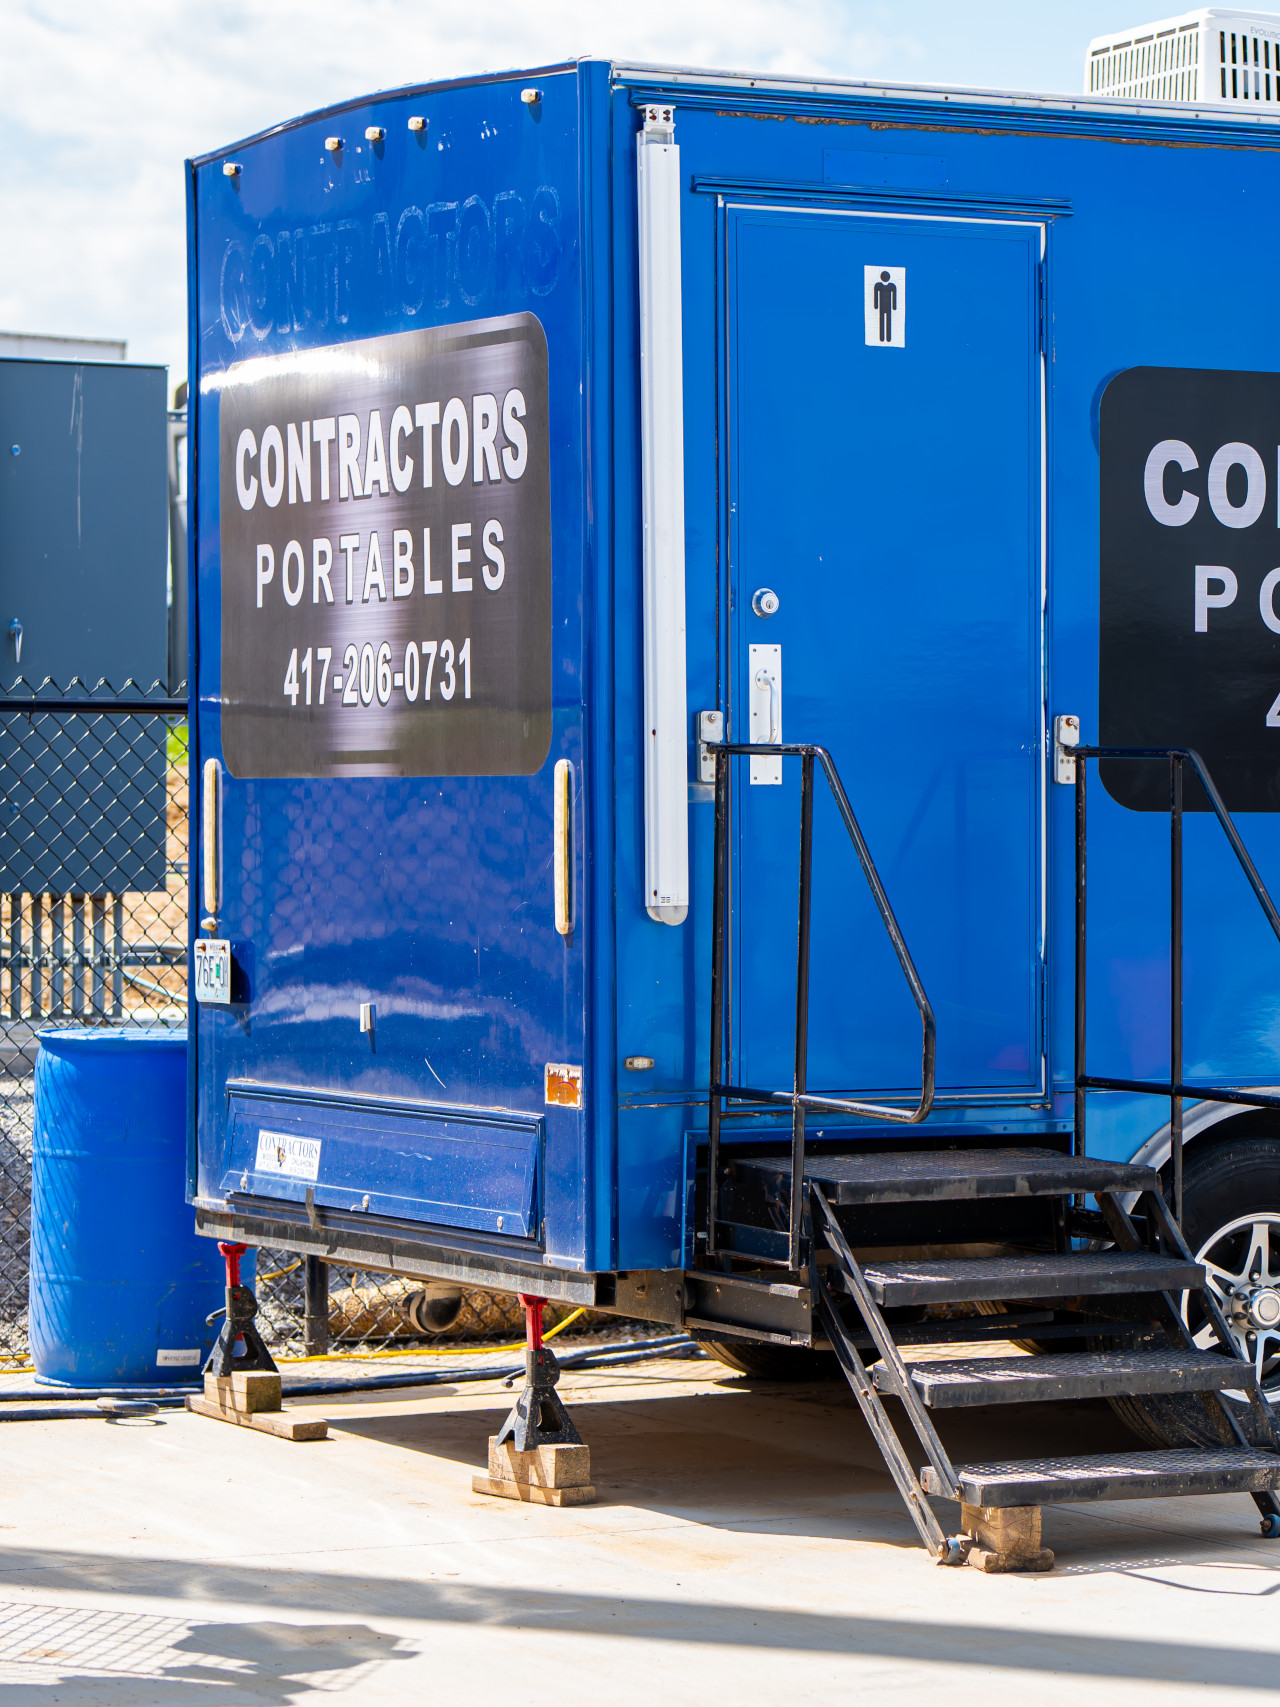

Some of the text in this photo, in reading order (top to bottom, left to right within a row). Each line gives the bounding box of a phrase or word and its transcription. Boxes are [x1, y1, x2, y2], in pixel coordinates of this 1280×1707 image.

[235, 387, 529, 511] CONTRACTORS
[255, 518, 506, 609] PORTABLES
[283, 637, 473, 707] 417-206-0731
[260, 1134, 318, 1160] CONTRACTORS
